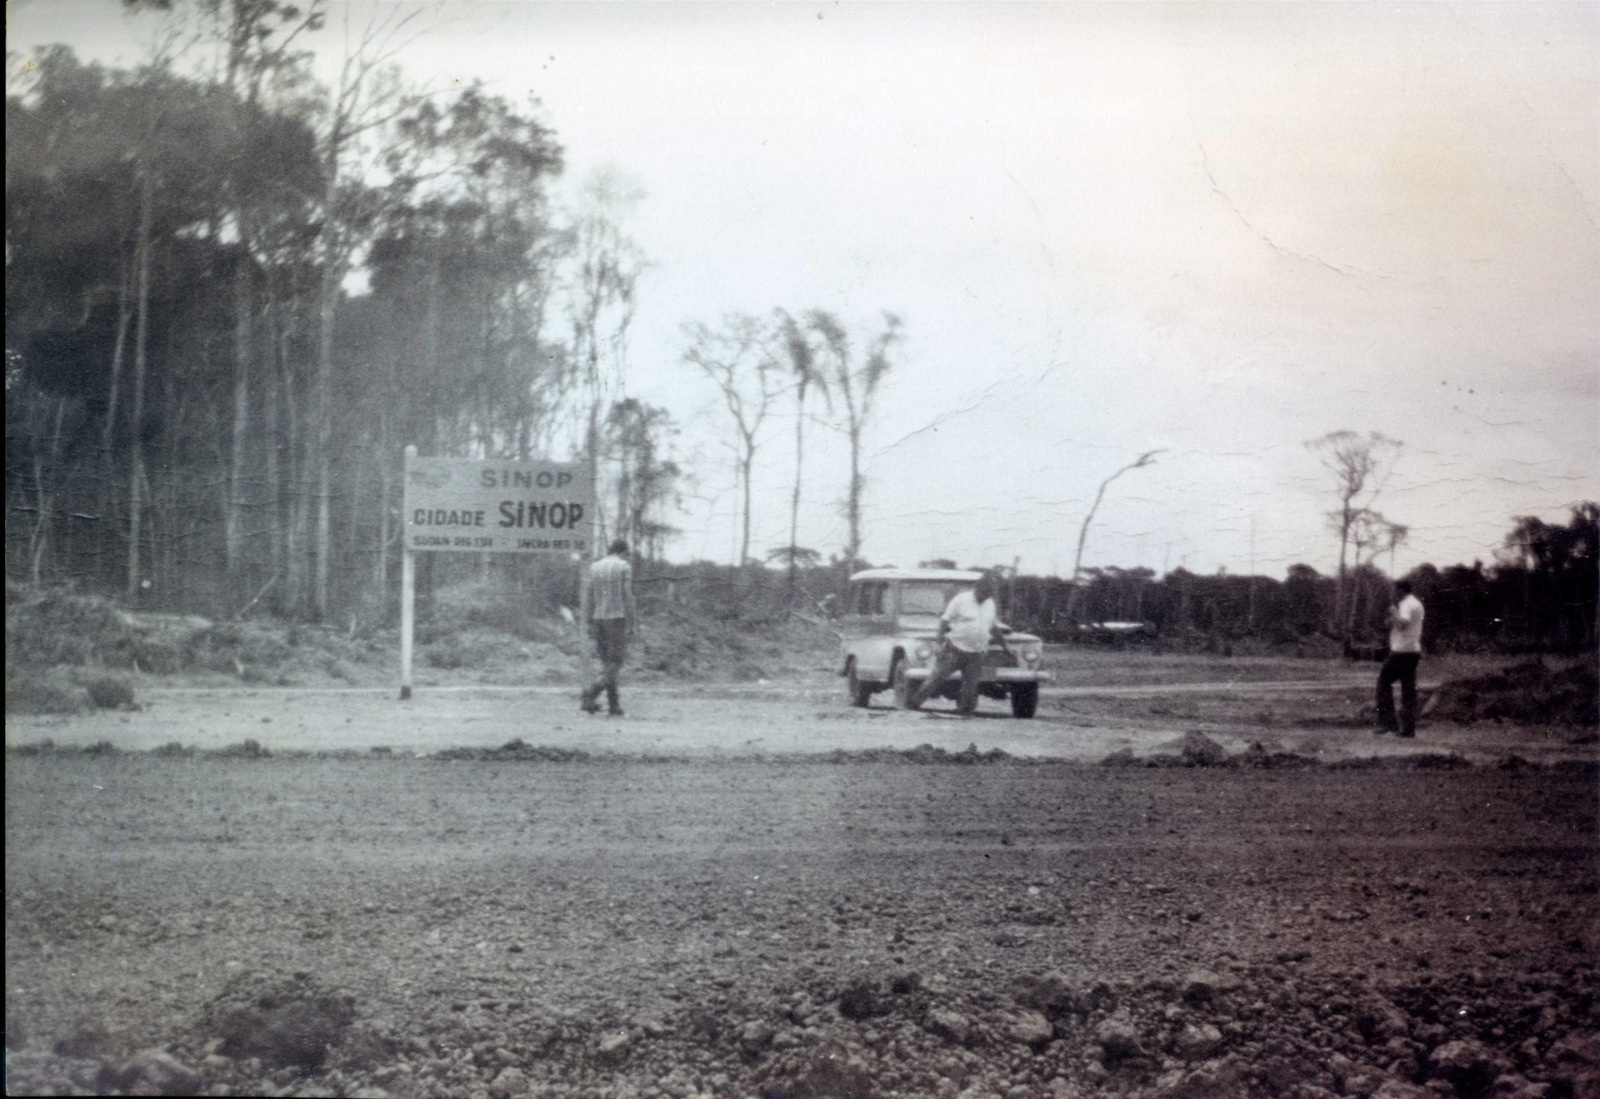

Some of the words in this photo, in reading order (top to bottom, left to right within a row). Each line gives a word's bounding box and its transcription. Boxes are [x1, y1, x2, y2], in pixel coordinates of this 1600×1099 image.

[481, 469, 572, 489] SINOP
[414, 508, 485, 526] CIDADE
[499, 500, 584, 529] SINOP
